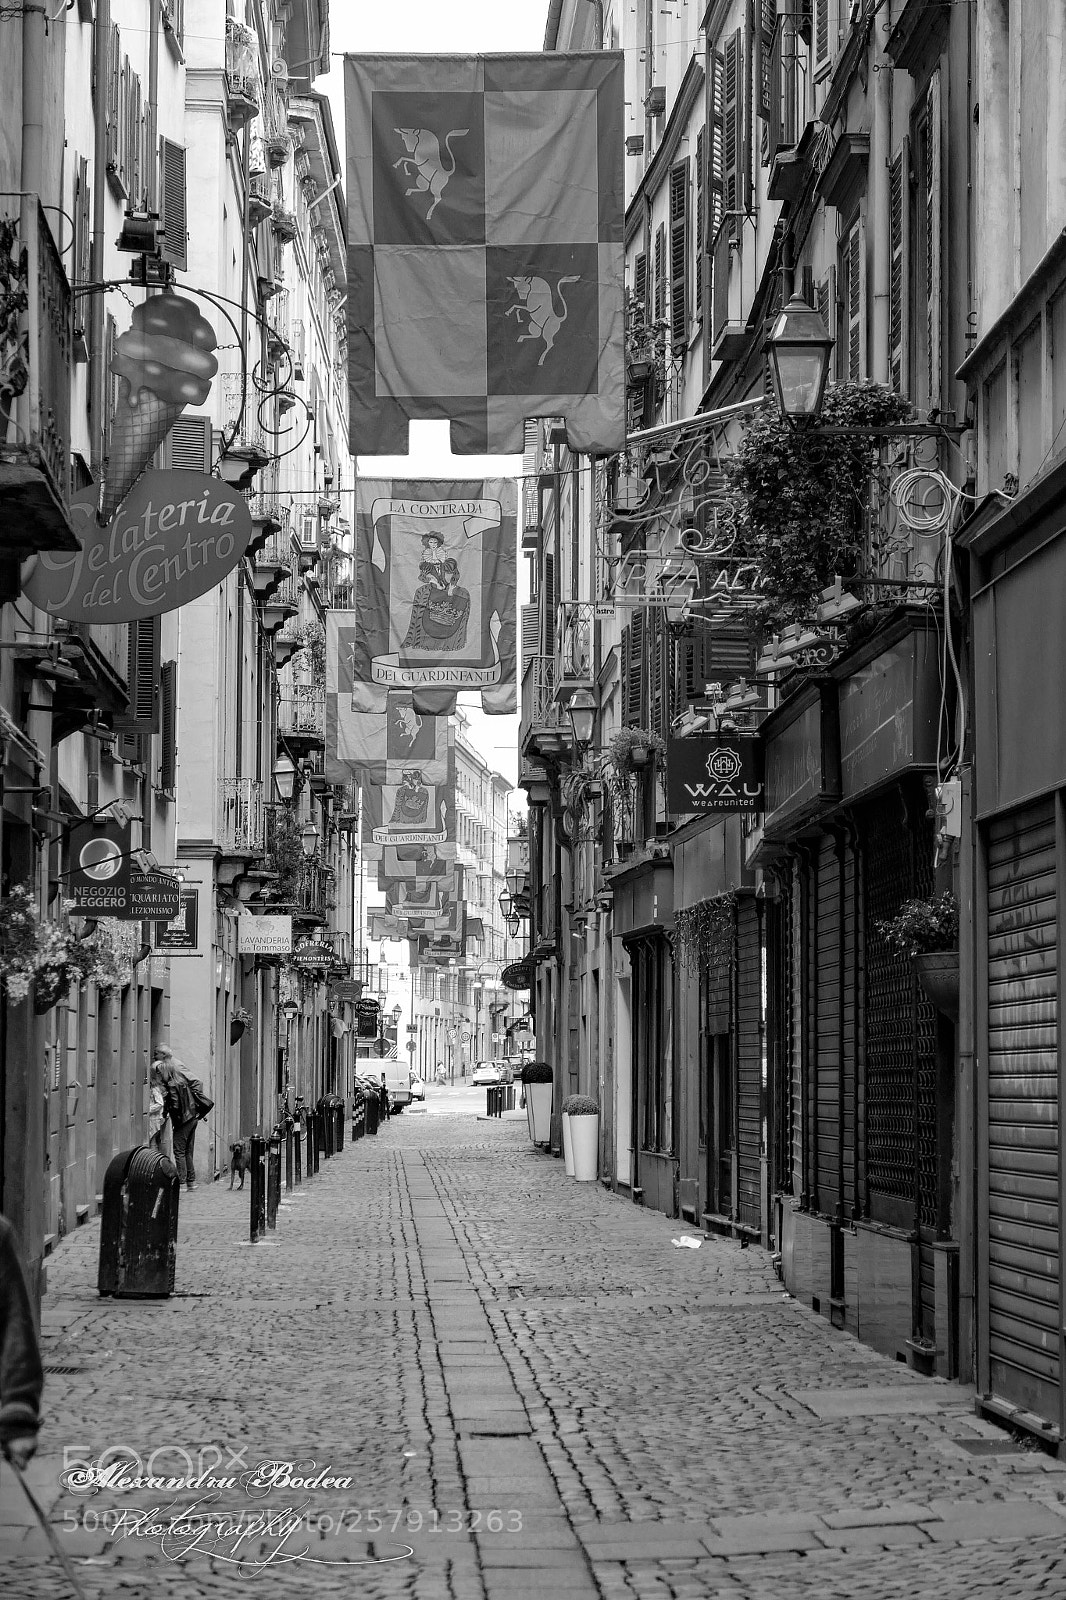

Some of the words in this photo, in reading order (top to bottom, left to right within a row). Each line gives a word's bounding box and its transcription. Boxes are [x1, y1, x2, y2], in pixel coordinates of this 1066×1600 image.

[389, 501, 406, 514] LA
[411, 501, 483, 515] CONTRADA
[40, 489, 236, 611] Gelateria
[82, 569, 122, 608] del
[128, 532, 235, 606] Centro
[376, 668, 397, 681] DEI
[401, 669, 497, 682] GUARDINFANTI
[390, 834, 443, 843] GUARDINFANTI
[136, 875, 157, 883] MONDO
[157, 877, 179, 890] ANTICO
[73, 886, 126, 897] NEGOZIO
[73, 897, 126, 908] LEGGERO
[240, 936, 290, 944] LAVANDERIA
[294, 940, 334, 953] GOFRERIA
[252, 944, 290, 952] Tommaso
